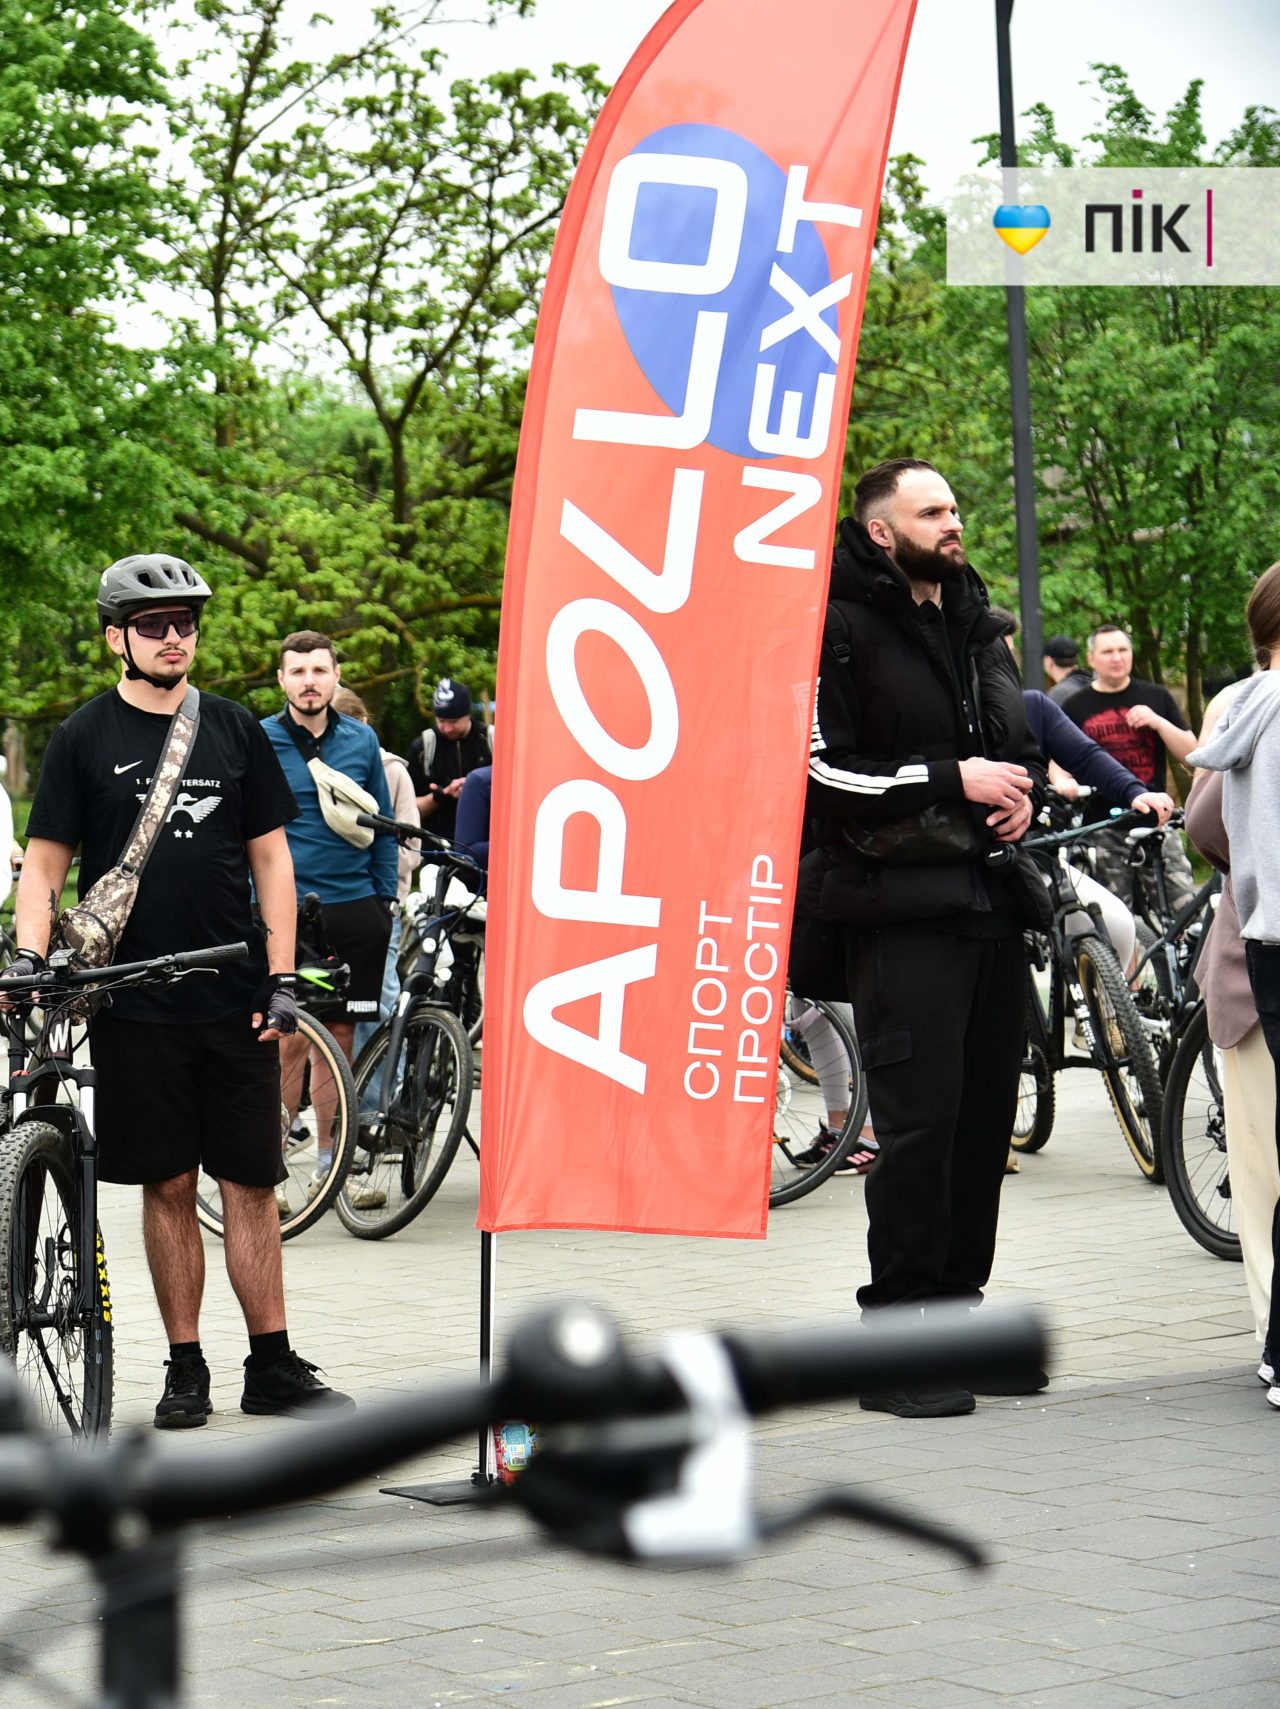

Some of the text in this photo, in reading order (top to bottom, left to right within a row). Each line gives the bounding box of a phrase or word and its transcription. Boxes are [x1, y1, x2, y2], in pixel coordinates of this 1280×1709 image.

[733, 164, 863, 570] NEXT
[523, 152, 748, 1095] APOLLO
[181, 779, 221, 788] TERSATZ
[683, 900, 733, 1100] СПОРТ
[733, 854, 784, 1103] ПРОСТІР
